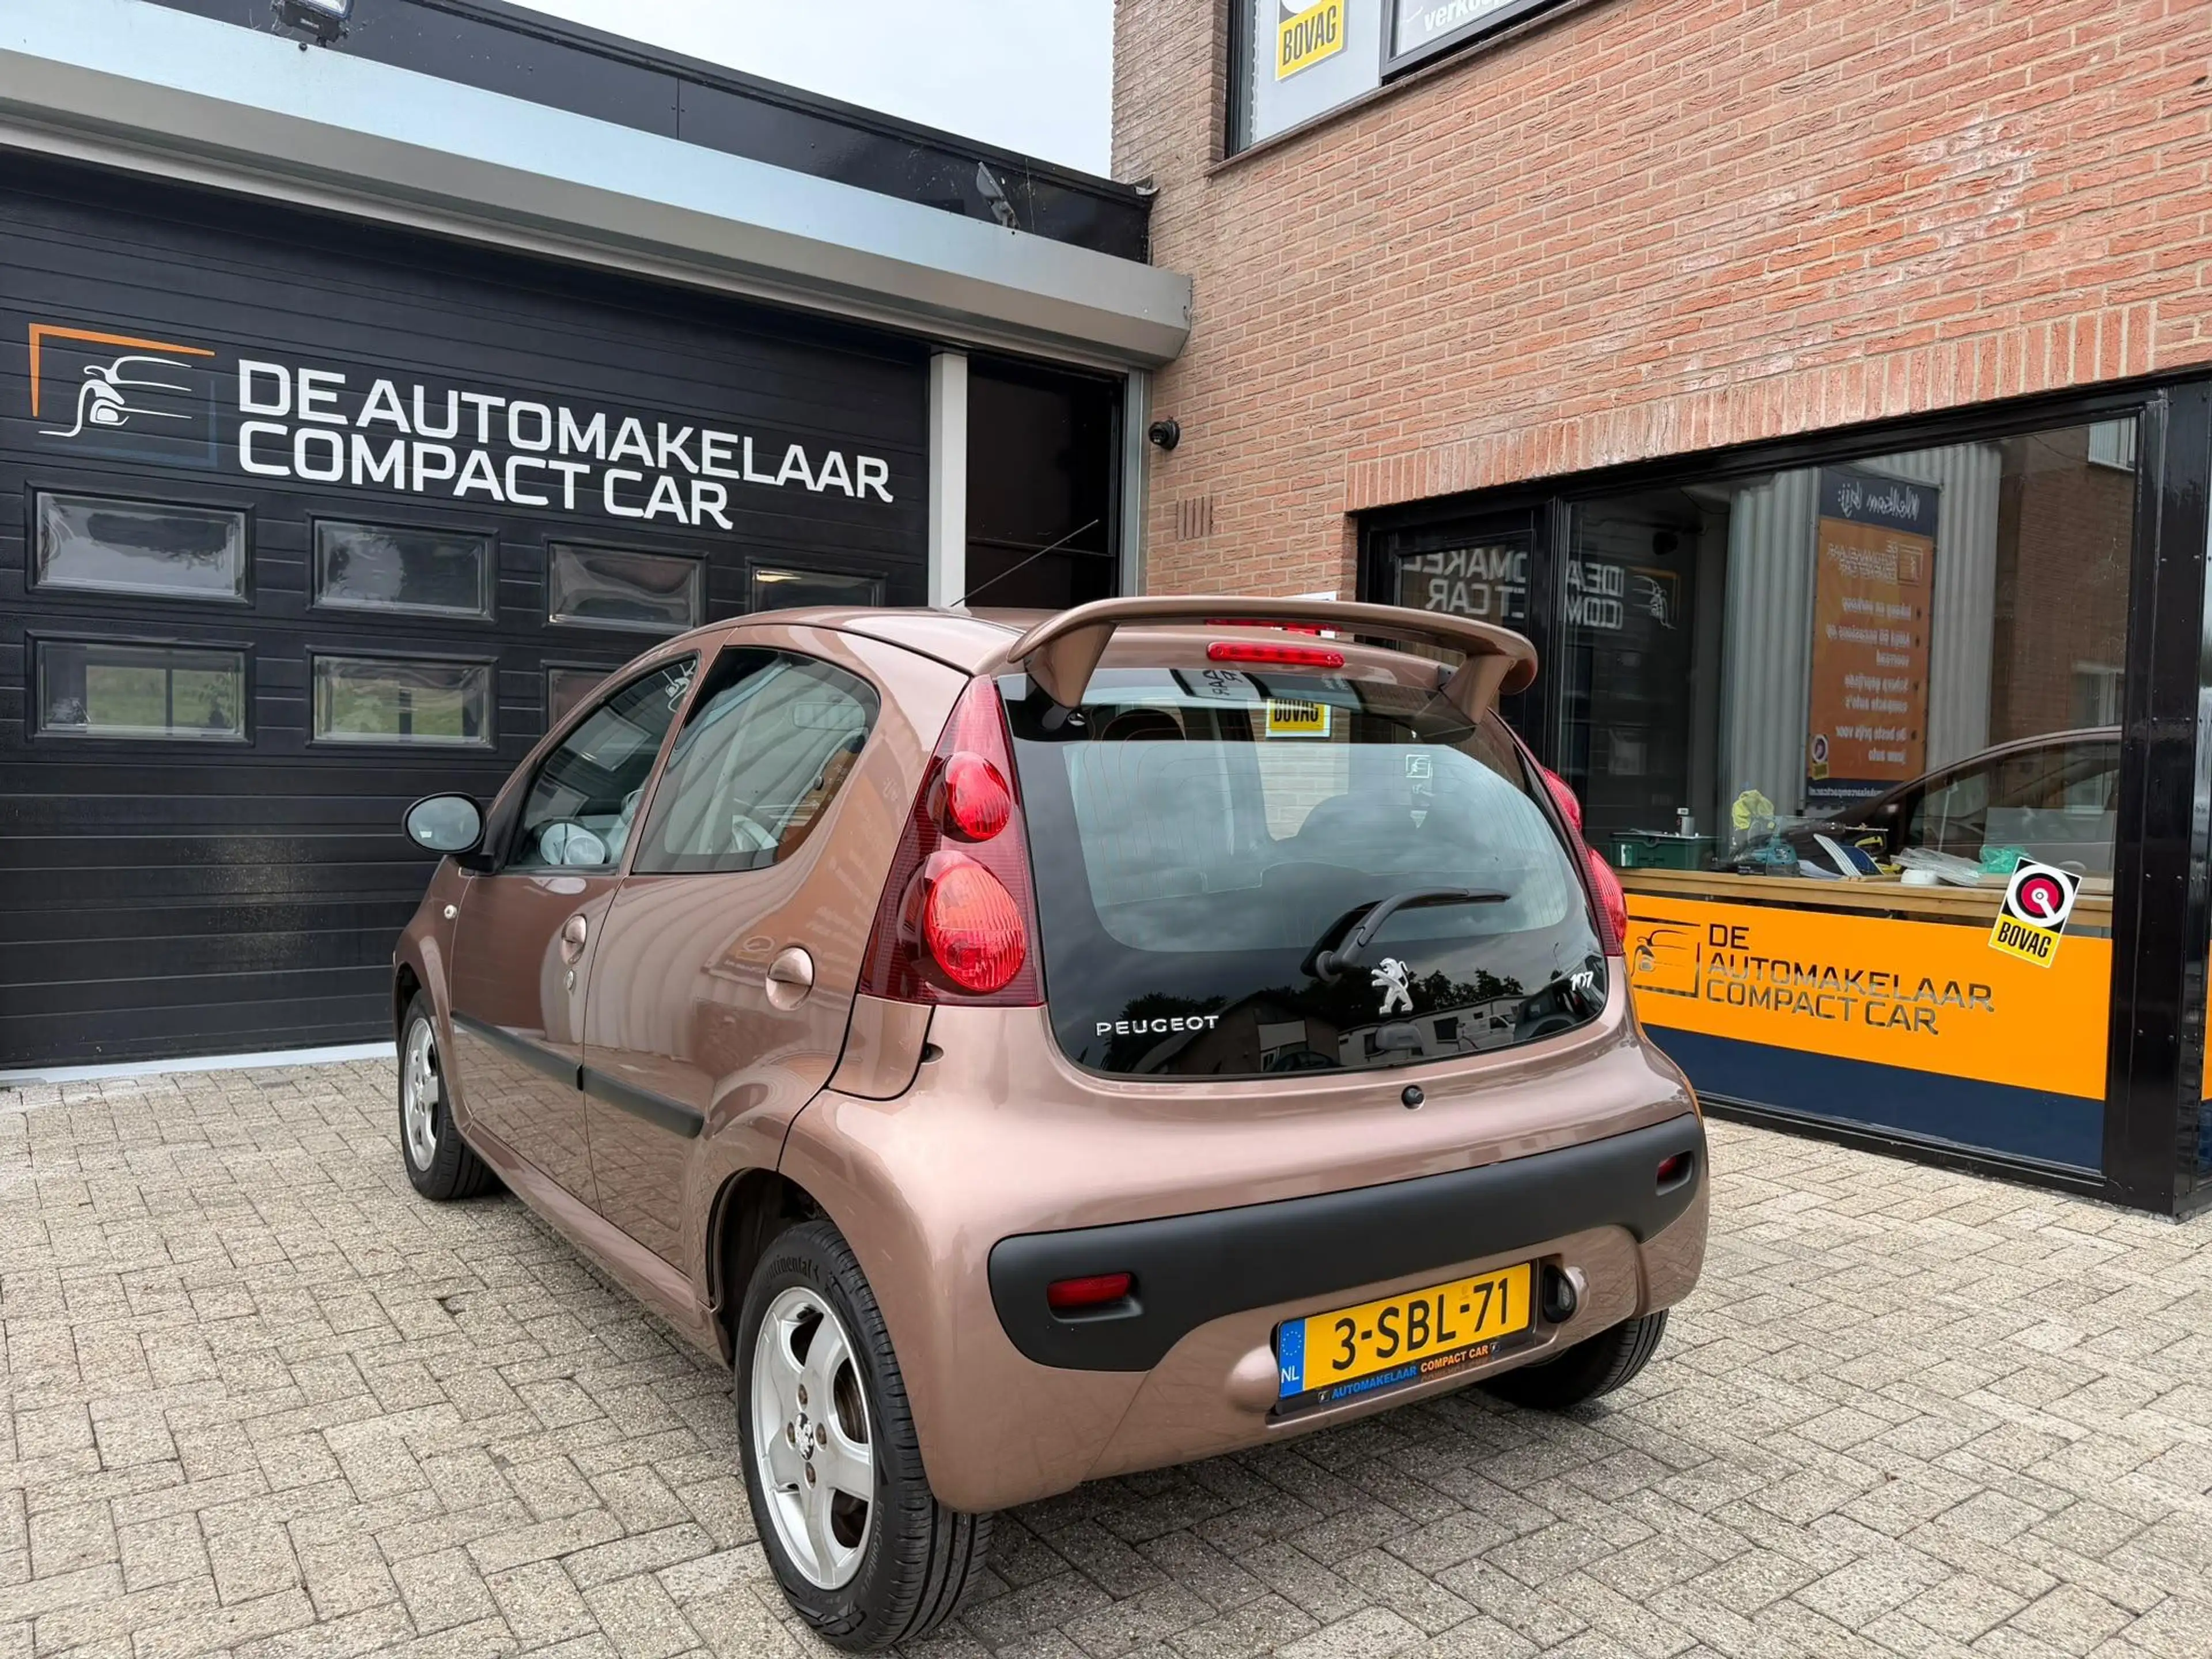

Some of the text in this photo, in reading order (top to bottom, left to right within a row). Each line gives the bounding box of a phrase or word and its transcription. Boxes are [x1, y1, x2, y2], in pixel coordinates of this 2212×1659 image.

[1283, 5, 1337, 66] BOVAG
[238, 359, 894, 503] DE AUTOMAKELAAR
[238, 421, 734, 530] COMPACT CAR
[1709, 923, 1750, 950] DE
[1998, 922, 2052, 958] BOVAG
[1570, 971, 1594, 991] 107
[1706, 979, 1939, 1035] COMPACT CAR
[1707, 952, 1995, 1012] AUTOMAKELAAR
[1096, 1015, 1219, 1036] PEUGEOT
[1331, 1277, 1509, 1371] 3-SBL-71
[1281, 1365, 1300, 1383] NL
[1331, 1344, 1489, 1400] AUTOMAKELAAR COMPACT CAR
